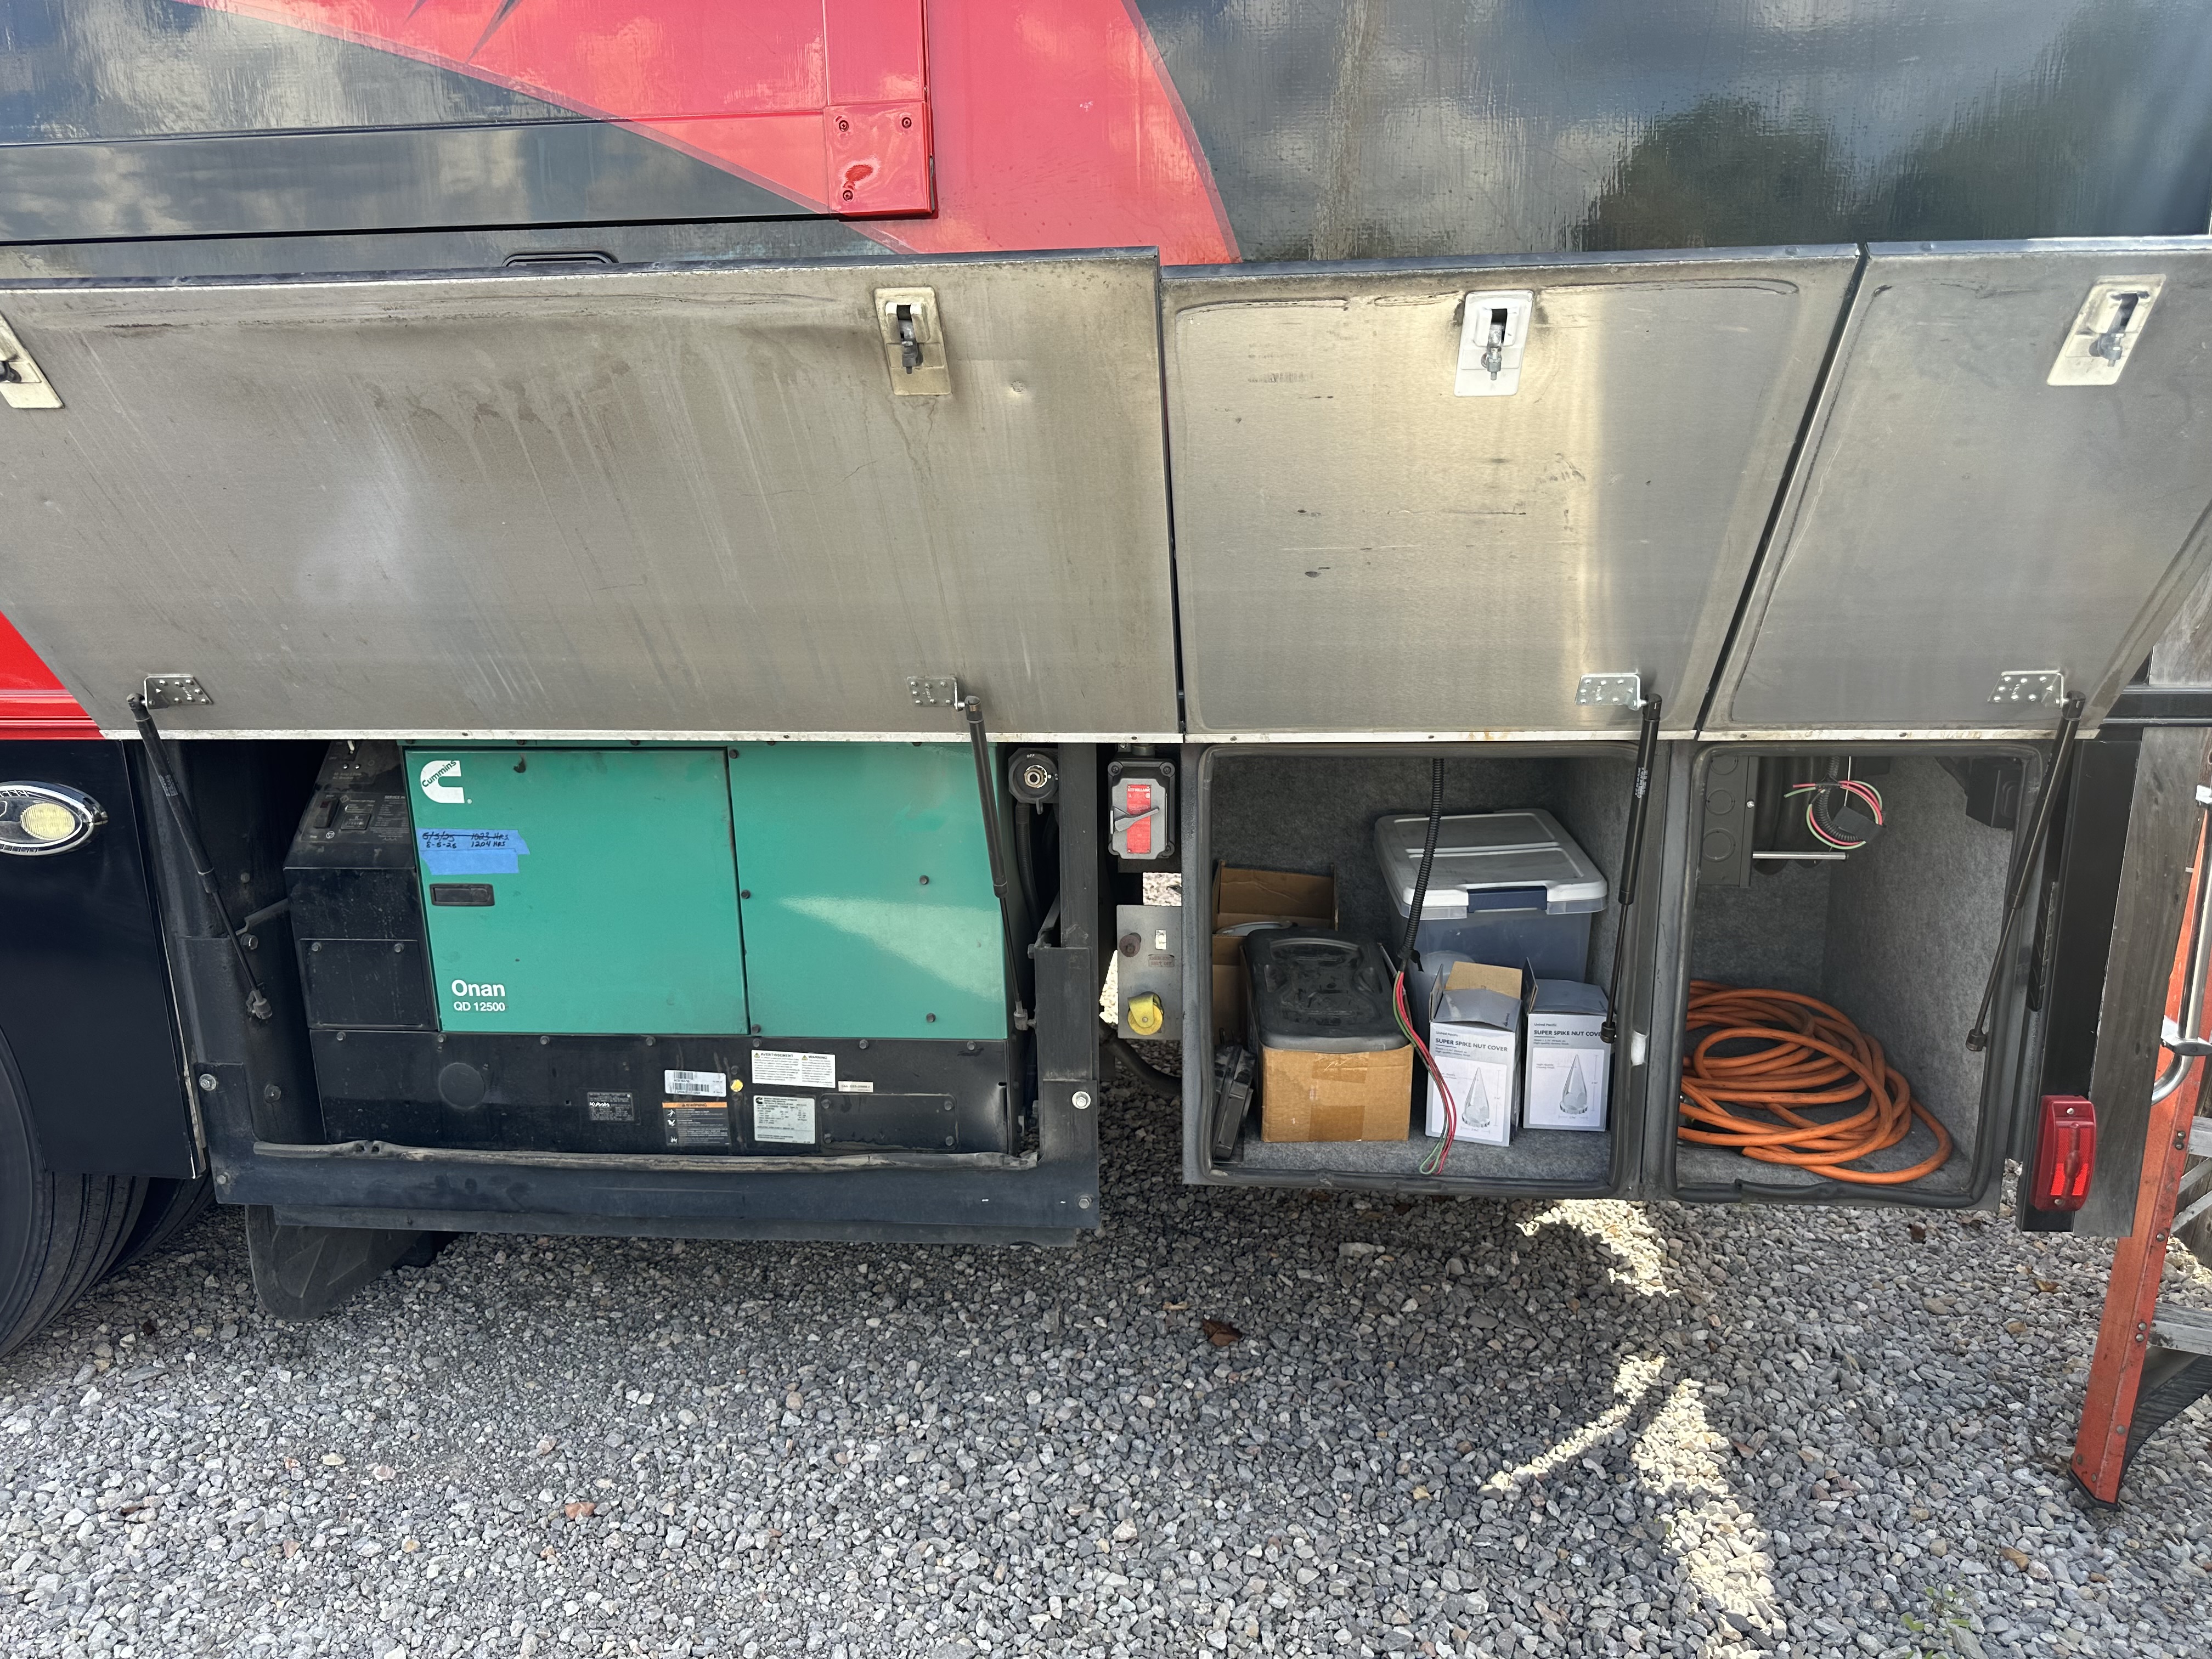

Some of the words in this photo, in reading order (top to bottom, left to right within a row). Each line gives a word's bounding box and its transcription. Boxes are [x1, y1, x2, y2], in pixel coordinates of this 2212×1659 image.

[422, 759, 457, 787] Cummins
[452, 979, 505, 996] Onan
[454, 1001, 471, 1011] QD
[473, 1002, 505, 1012] 12500
